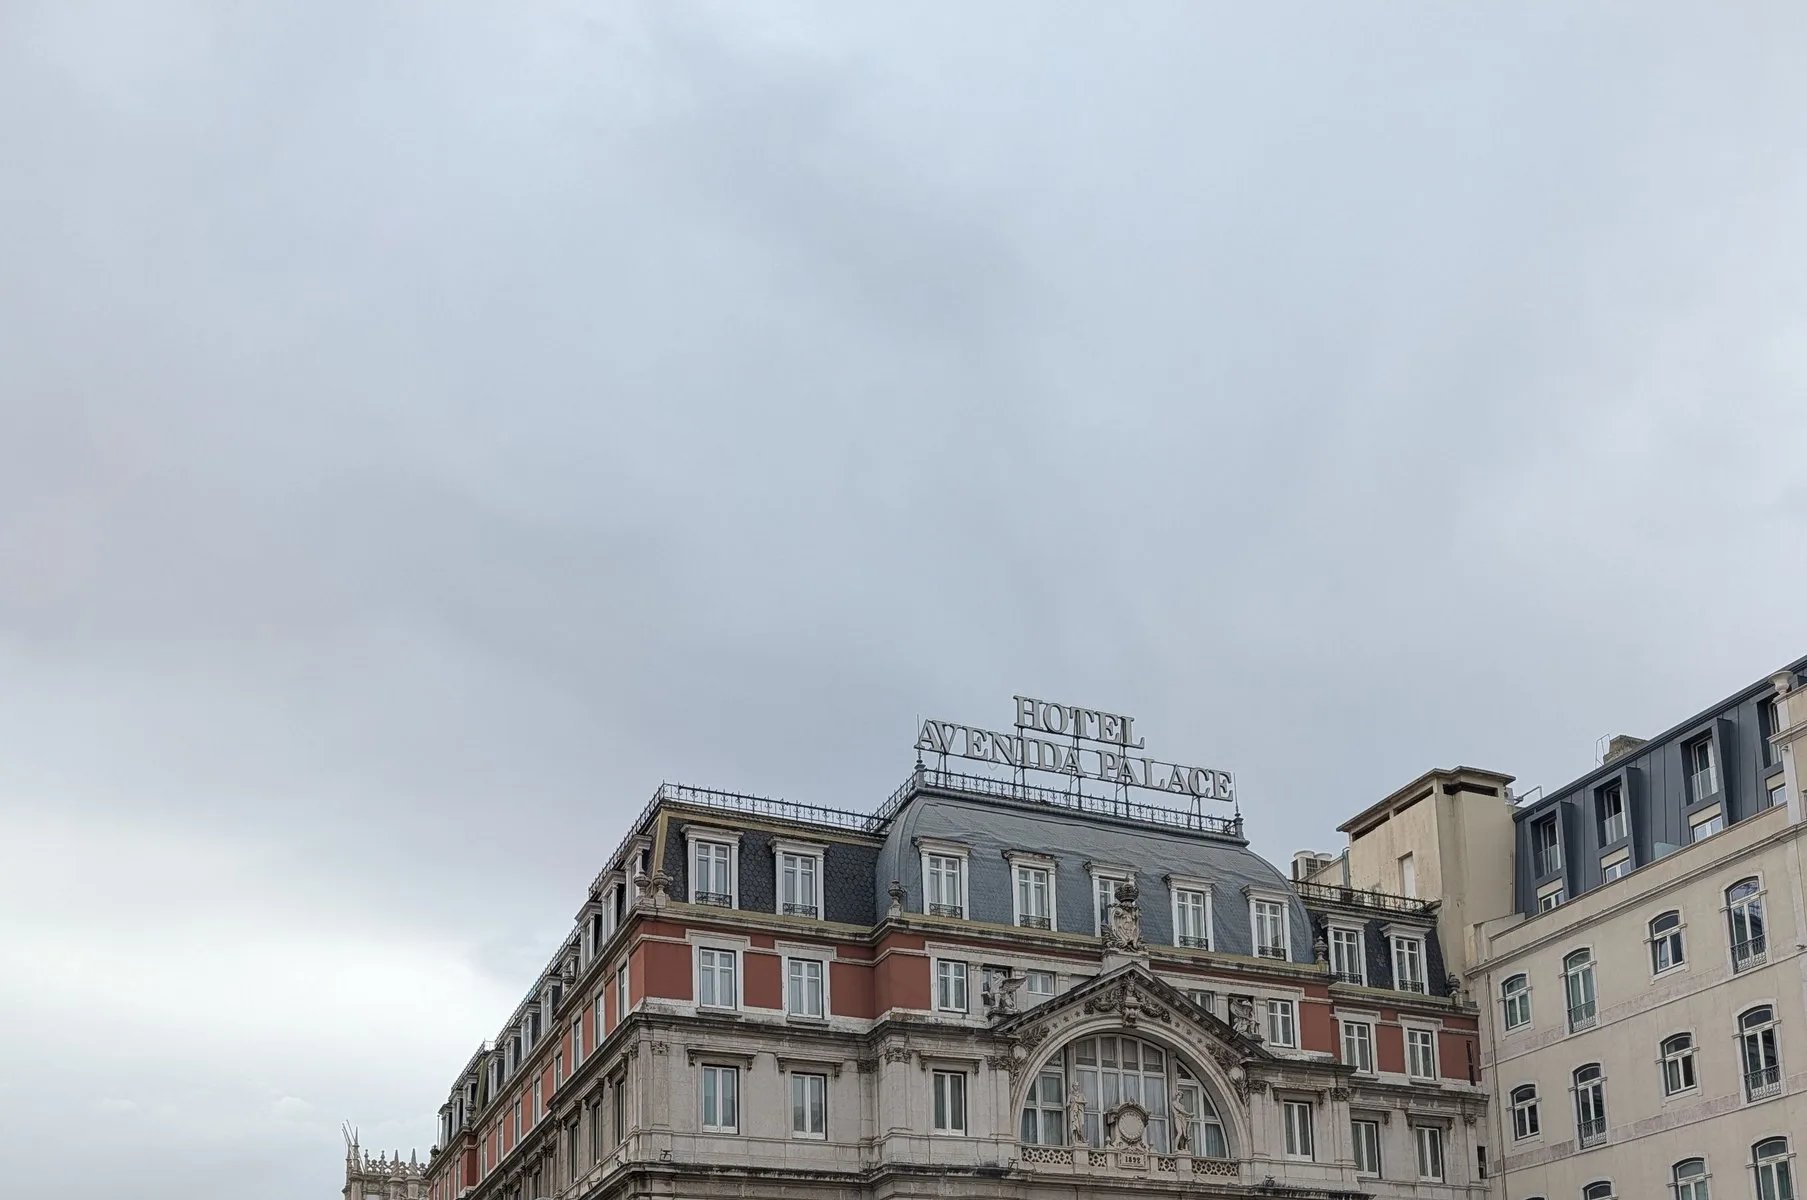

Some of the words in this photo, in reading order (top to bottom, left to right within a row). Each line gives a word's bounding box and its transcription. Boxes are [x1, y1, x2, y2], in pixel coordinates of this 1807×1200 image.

[1013, 695, 1145, 749] HOTEL
[913, 719, 1086, 777] AVENIDA
[1096, 749, 1234, 802] PALACE
[1125, 1155, 1141, 1164] 1892
